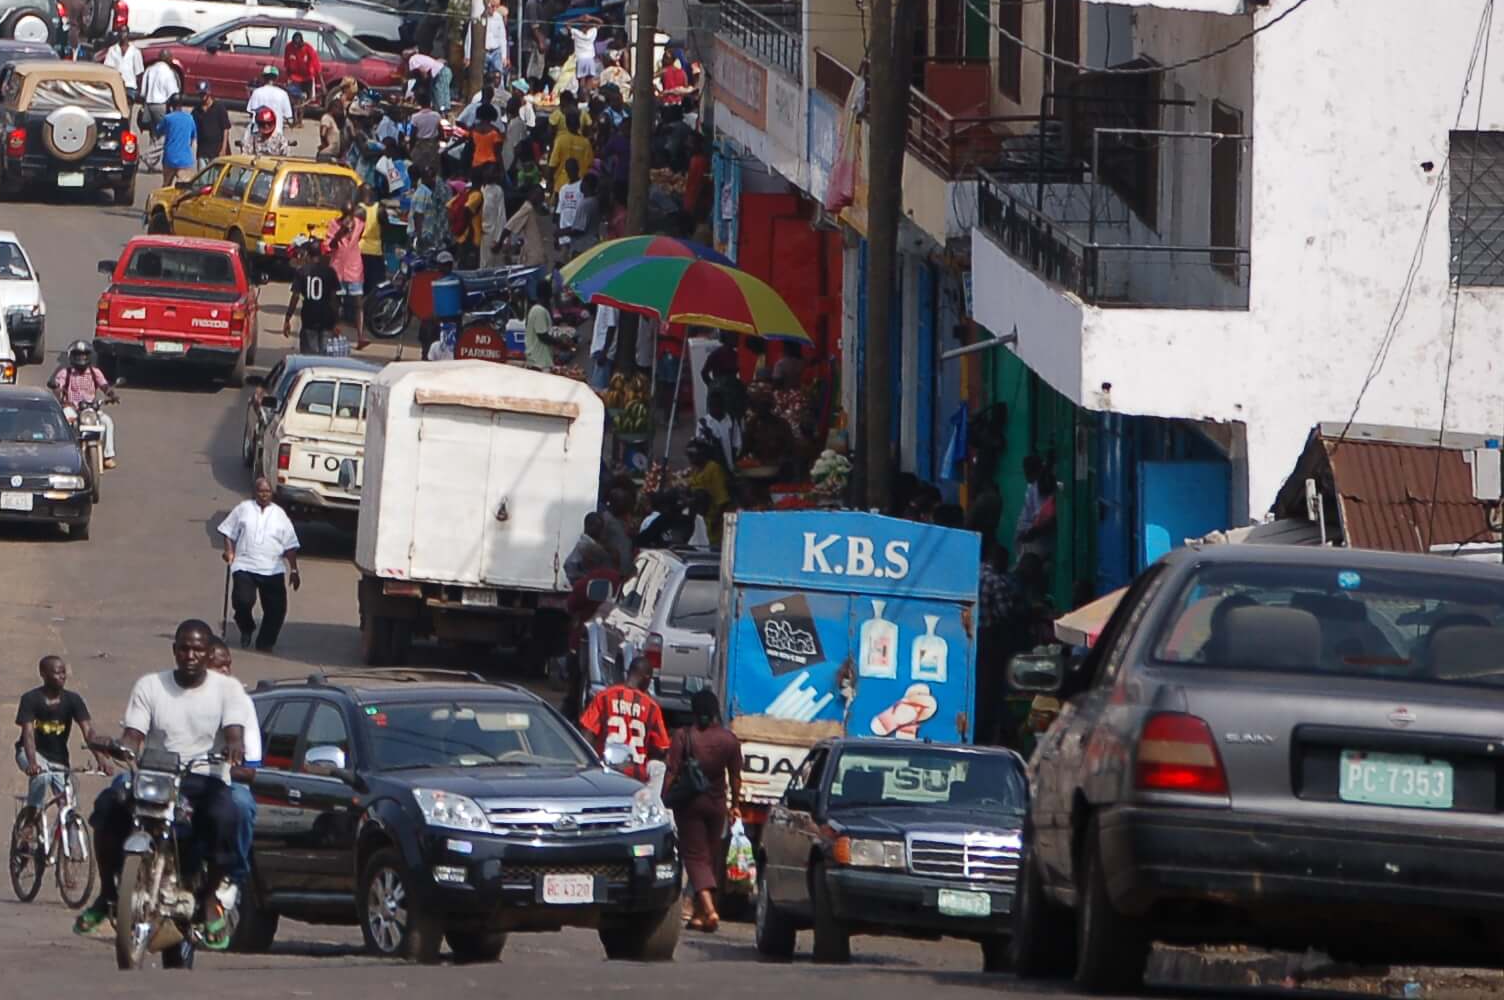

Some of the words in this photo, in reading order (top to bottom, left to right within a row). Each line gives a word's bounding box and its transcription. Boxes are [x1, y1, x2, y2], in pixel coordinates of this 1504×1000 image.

[306, 275, 324, 301] 10
[191, 317, 230, 329] mazda
[474, 333, 492, 345] NO
[460, 347, 501, 360] PARKING
[801, 531, 911, 580] K.B.S
[606, 715, 647, 764] 22
